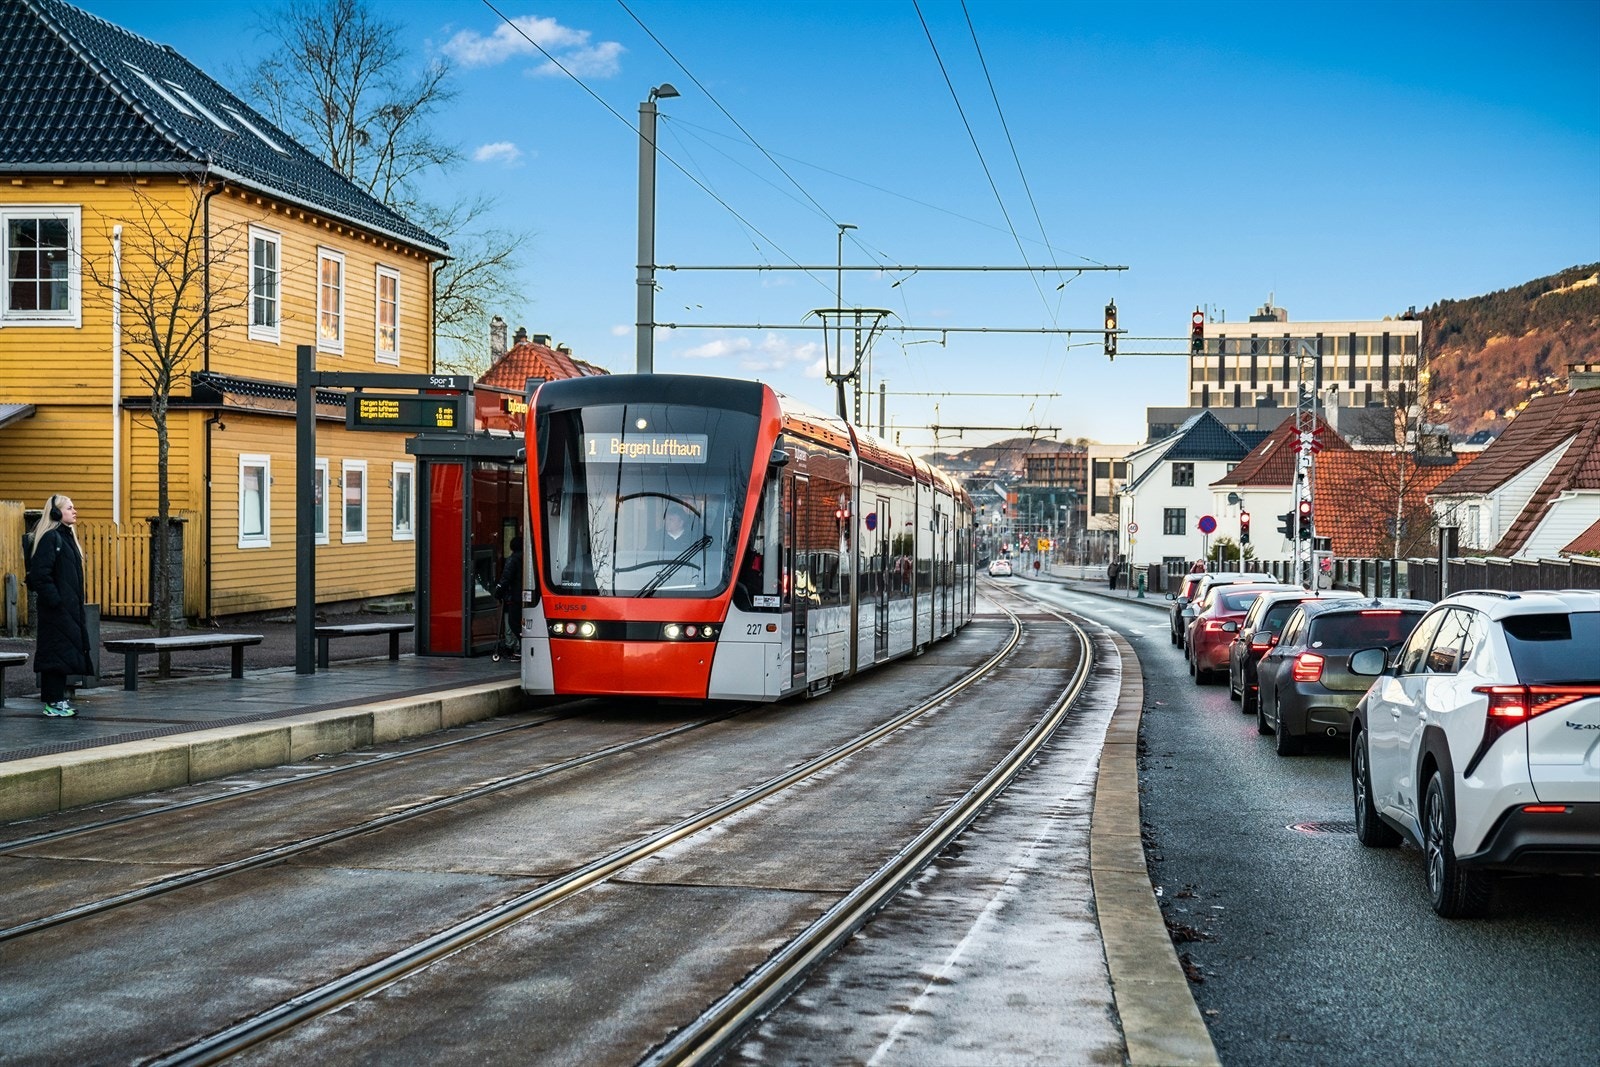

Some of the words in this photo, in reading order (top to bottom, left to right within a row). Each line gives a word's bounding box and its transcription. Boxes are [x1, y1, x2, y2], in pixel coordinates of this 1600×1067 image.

[430, 377, 447, 385] Spor
[448, 378, 455, 388] 1
[588, 440, 597, 455] 1
[610, 438, 651, 458] Bergen
[652, 439, 701, 456] lufthavn
[554, 603, 579, 612] skyss
[746, 623, 762, 635] 227
